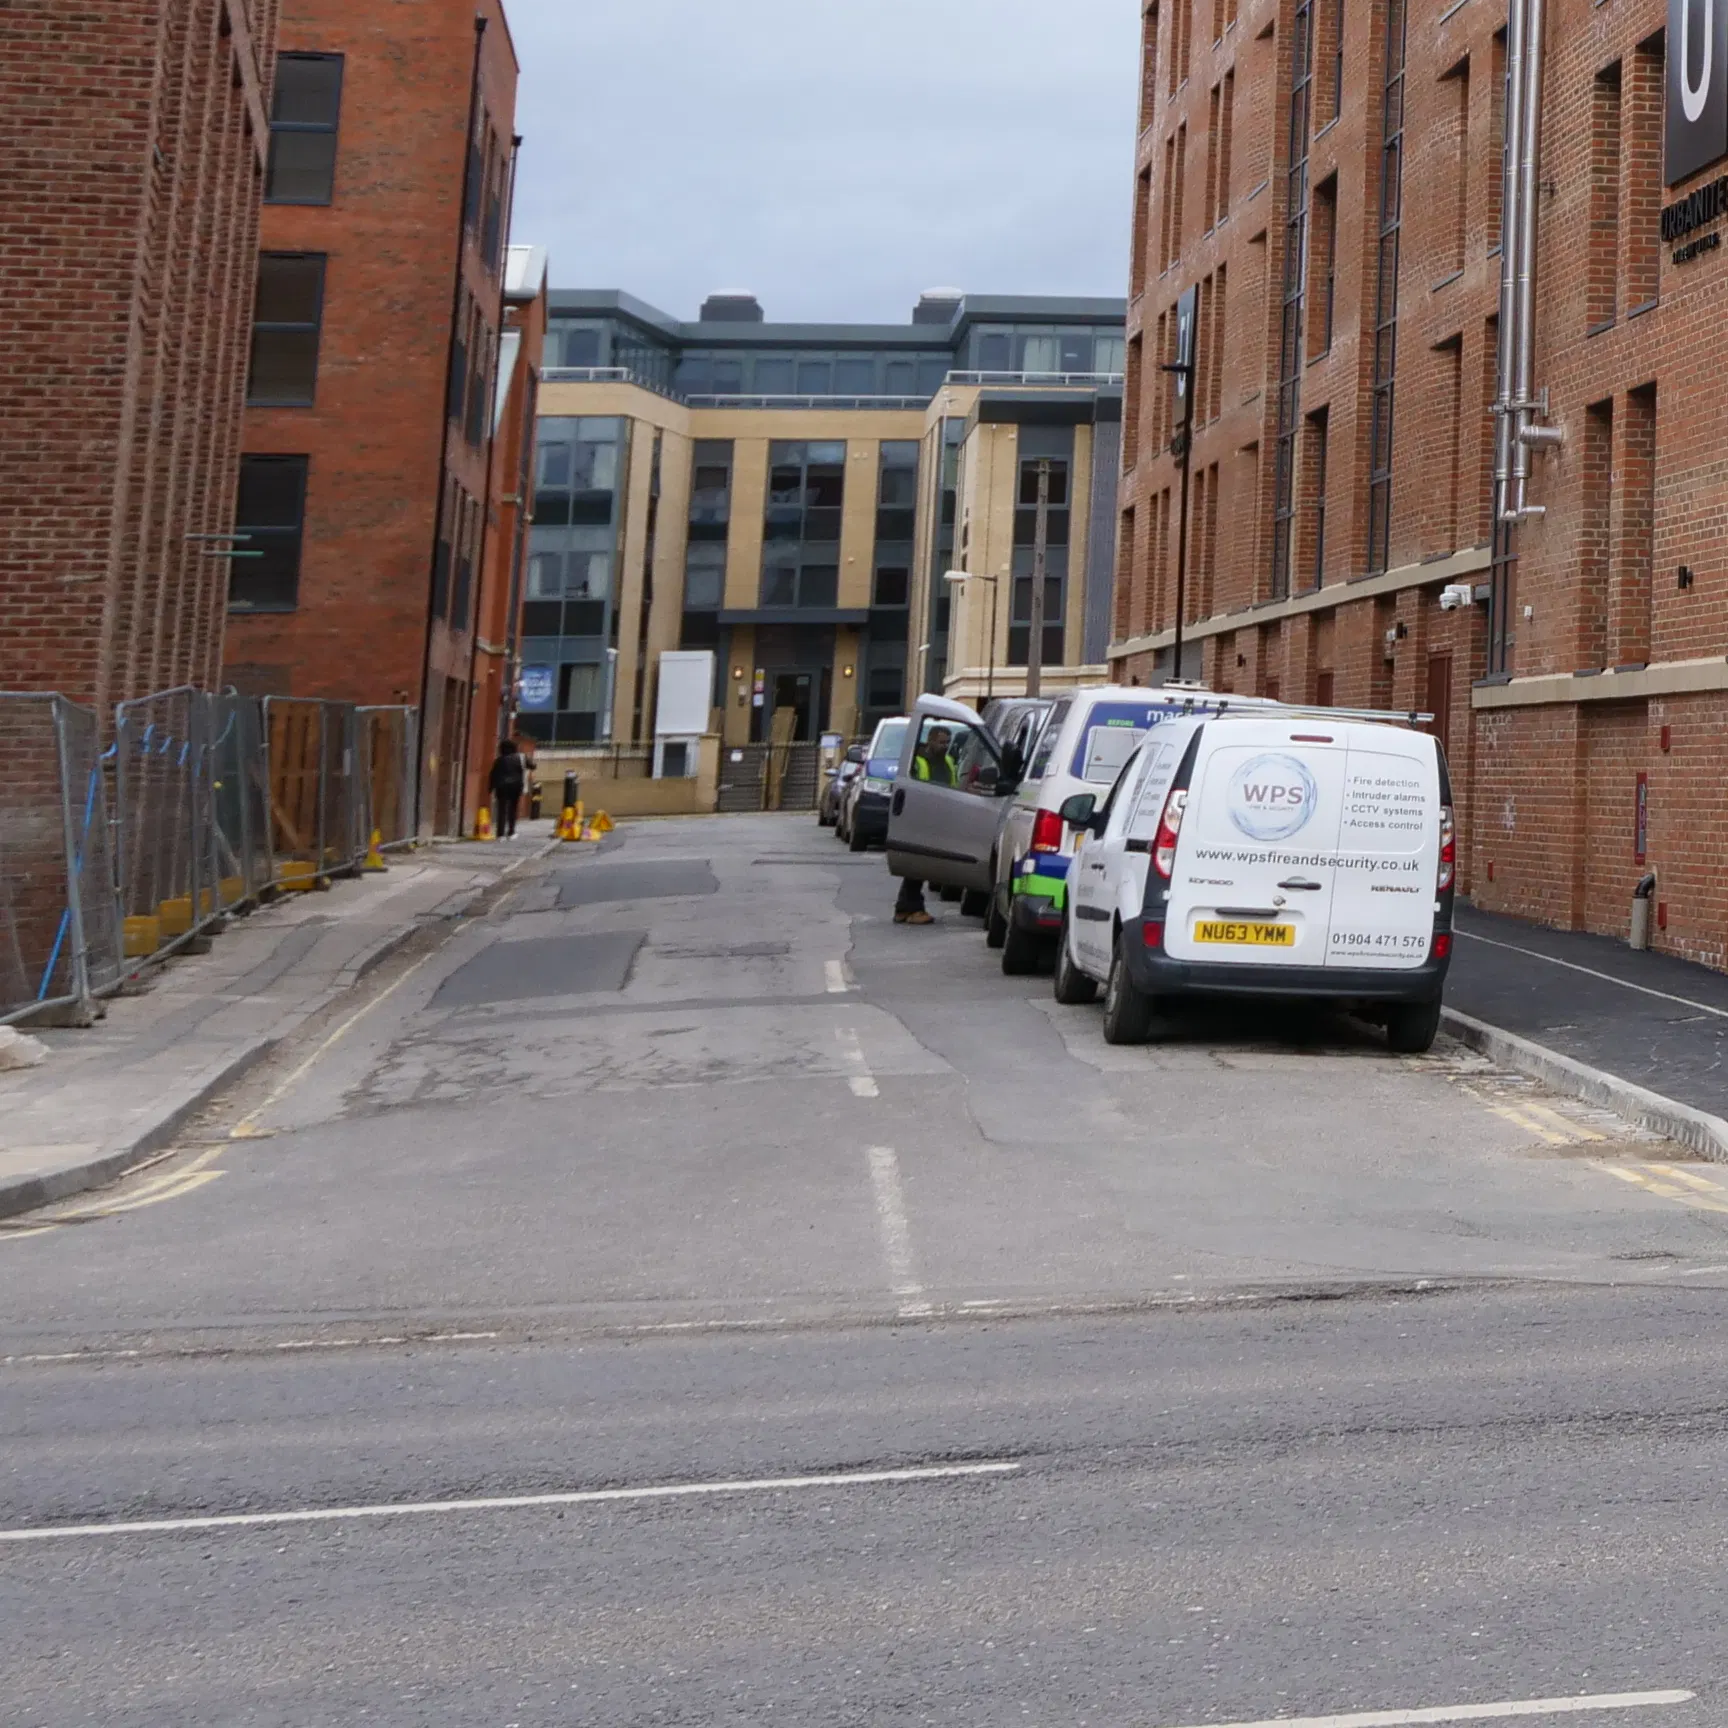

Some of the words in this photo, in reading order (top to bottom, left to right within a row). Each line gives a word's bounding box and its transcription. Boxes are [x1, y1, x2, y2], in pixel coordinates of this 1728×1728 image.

[1353, 776, 1372, 785] Fire
[1375, 777, 1420, 788] detection
[1243, 783, 1303, 804] WPS
[1352, 789, 1391, 800] Intruder
[1393, 793, 1426, 803] alarms
[1351, 804, 1379, 813] CCTV
[1383, 806, 1423, 817] systems
[1350, 819, 1385, 828] Access
[1388, 822, 1422, 831] control
[1195, 849, 1419, 872] www.wpsfireandsecurity.co.uk
[1201, 923, 1248, 941] NU63
[1254, 925, 1287, 943] YMM
[1332, 933, 1371, 945] 01904
[1375, 934, 1398, 946] 471
[1402, 936, 1425, 948] 576
